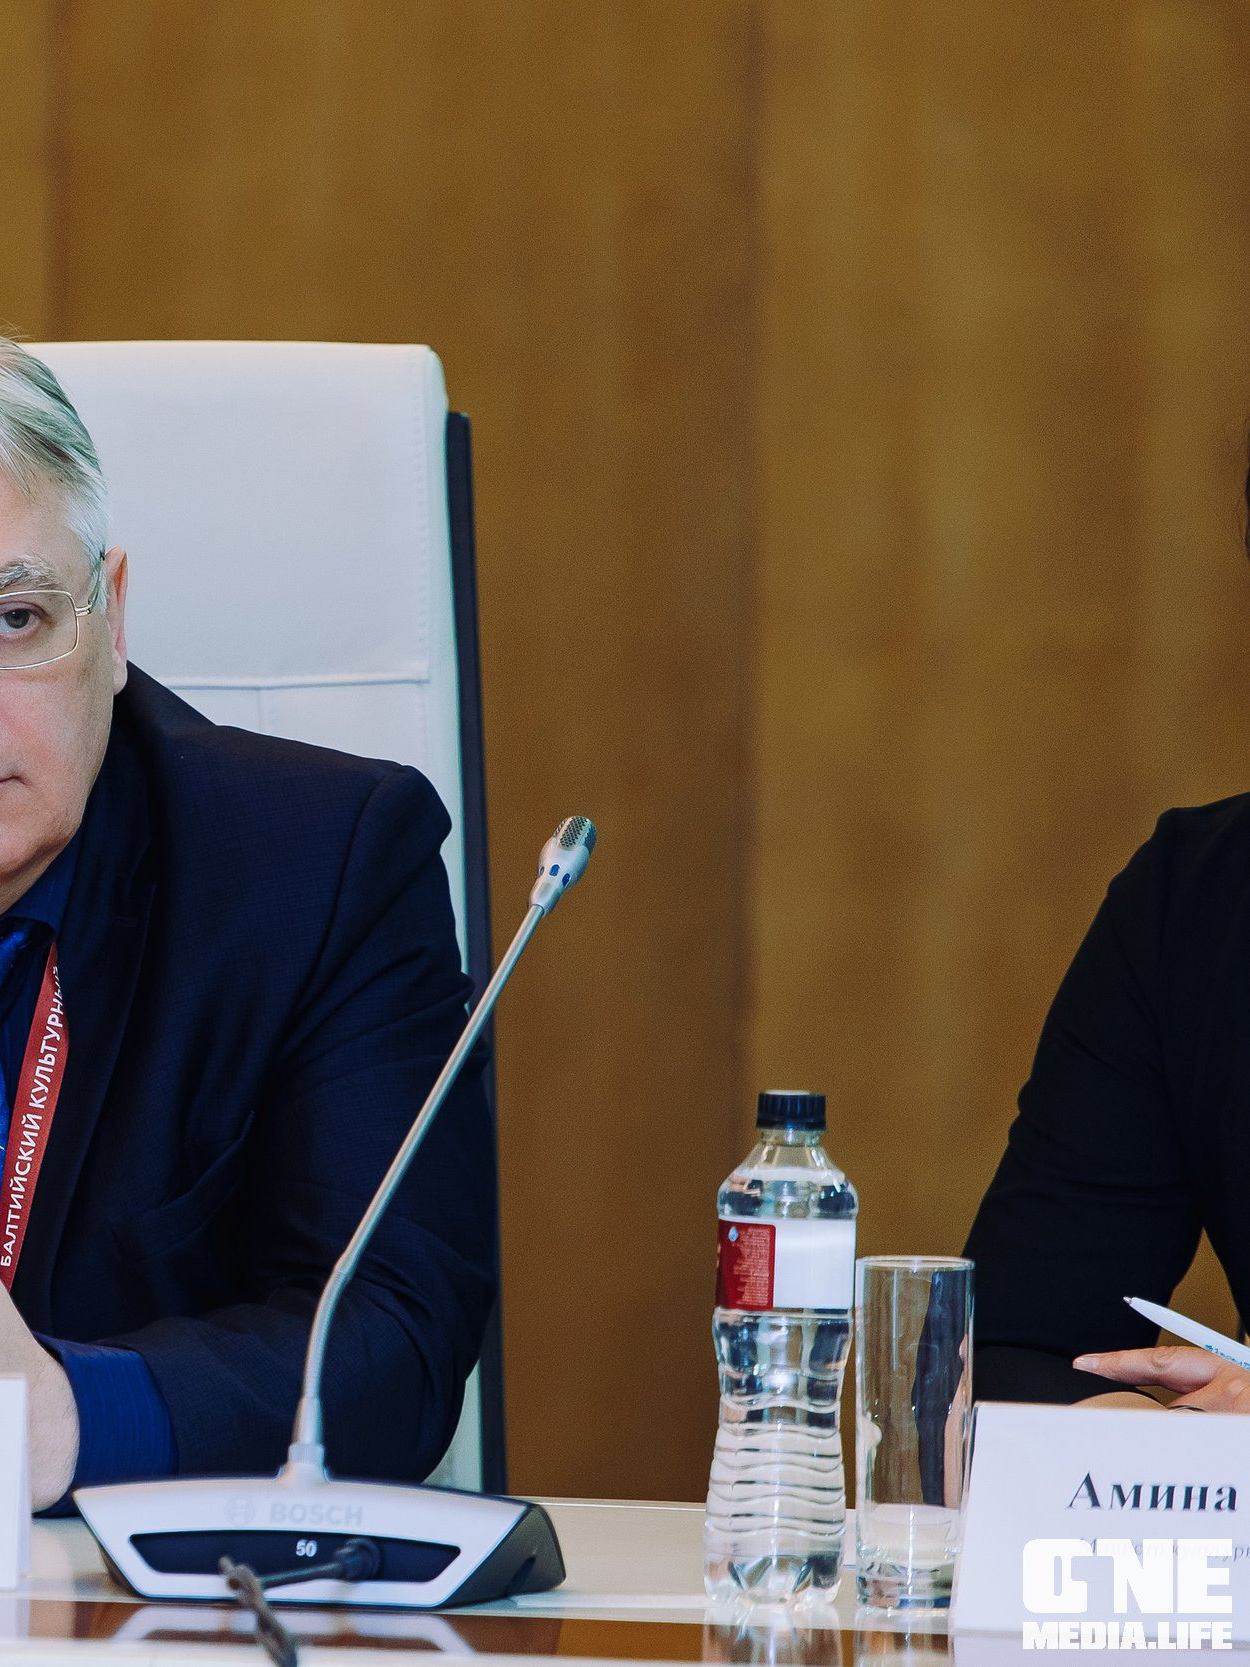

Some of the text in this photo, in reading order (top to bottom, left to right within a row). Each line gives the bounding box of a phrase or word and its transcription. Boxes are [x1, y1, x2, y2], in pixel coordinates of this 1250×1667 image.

[0, 1112, 42, 1267] БАЛТИЙСКИЙ
[1066, 1471, 1238, 1512] Амина
[270, 1503, 363, 1526] BOSCH
[295, 1539, 317, 1557] 50
